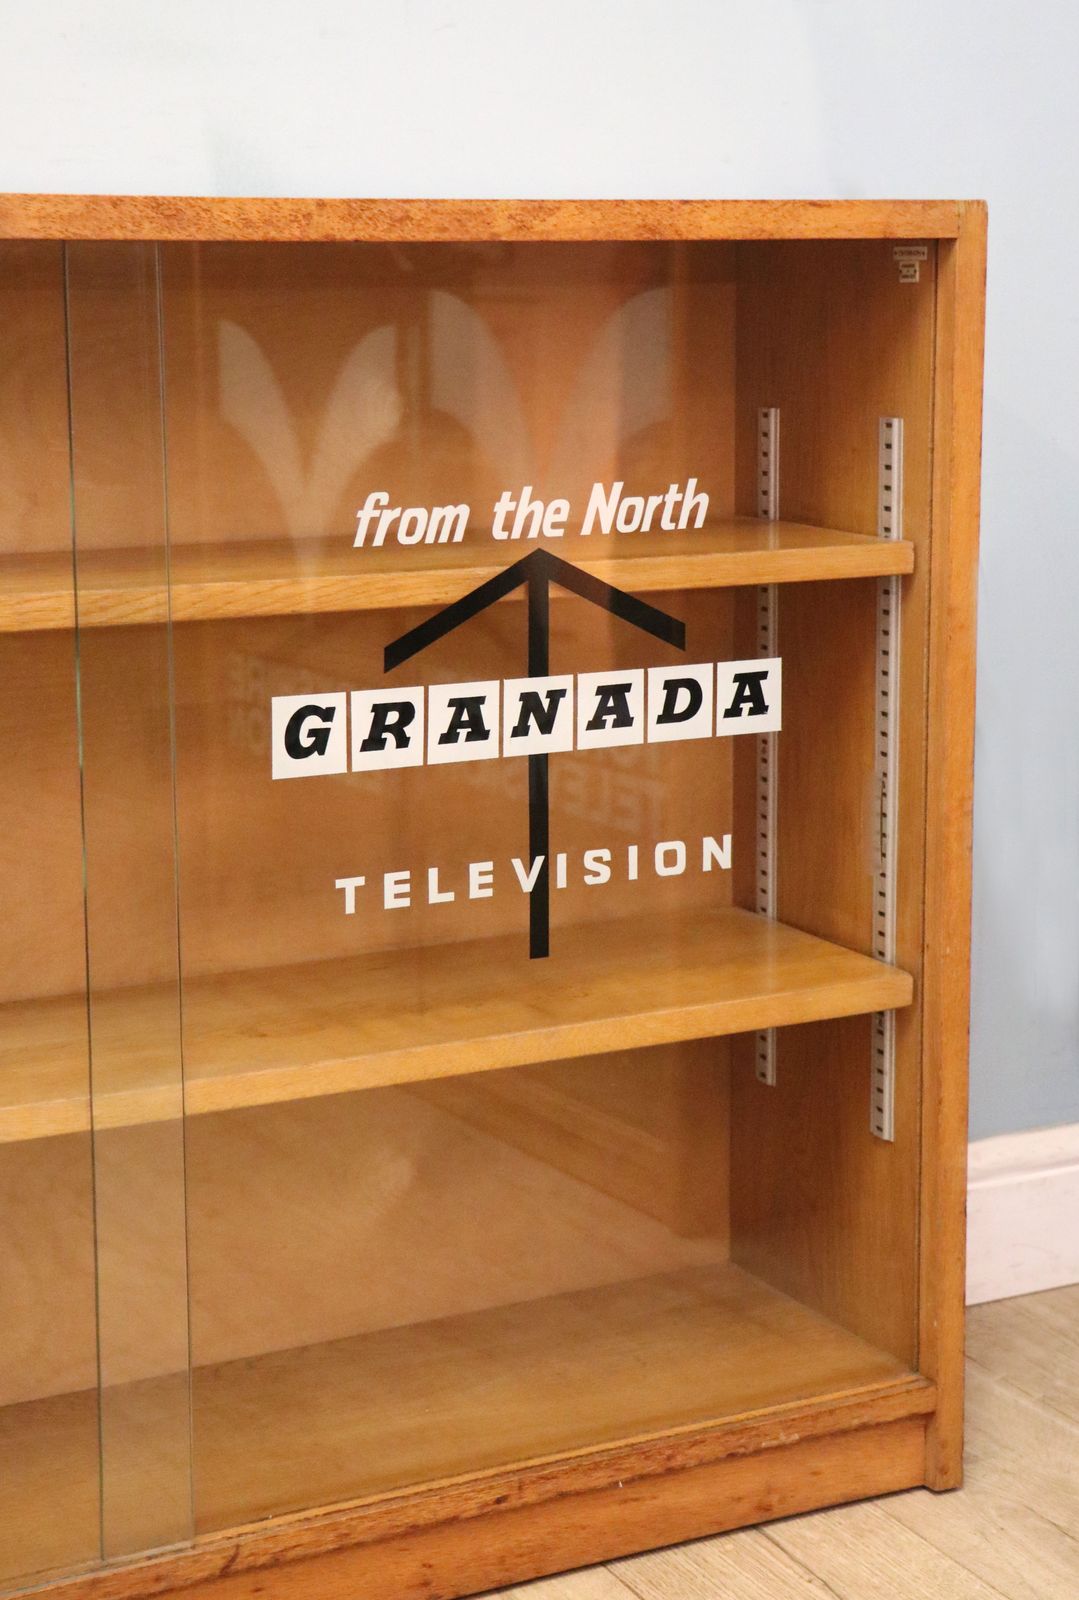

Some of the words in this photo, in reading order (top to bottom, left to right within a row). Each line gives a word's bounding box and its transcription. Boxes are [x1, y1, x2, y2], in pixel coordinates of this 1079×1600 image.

[353, 491, 470, 548] from
[492, 485, 570, 540] the
[580, 478, 709, 535] North
[283, 670, 770, 761] GRANADA
[335, 834, 732, 914] TELEVISION
